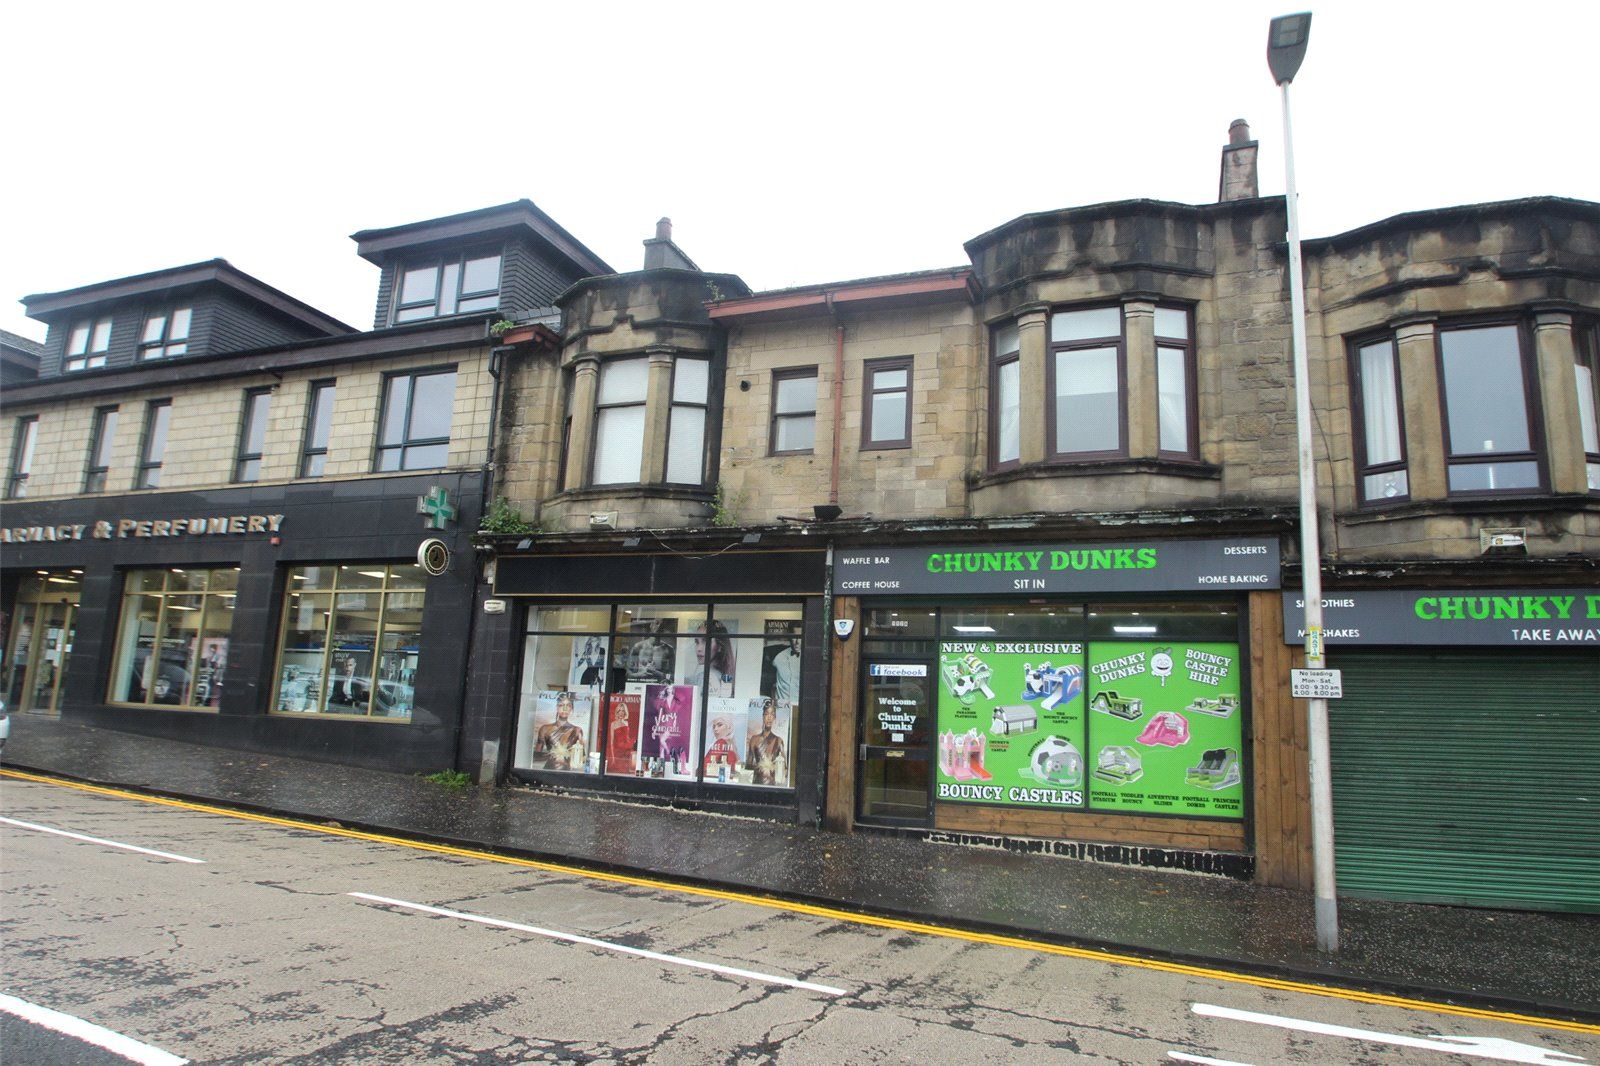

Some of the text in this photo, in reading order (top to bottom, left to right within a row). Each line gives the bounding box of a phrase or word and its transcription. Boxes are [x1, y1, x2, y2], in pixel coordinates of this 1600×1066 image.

[92, 520, 113, 539] &
[117, 513, 285, 539] PERFUMERY
[1224, 546, 1267, 555] DESSERTS
[842, 556, 890, 565] WAFFLE BAR
[926, 548, 1157, 573] CHUNKY DUNKS
[841, 580, 900, 589] COFFEE HOUSE
[1013, 578, 1046, 589] SIT IN
[1198, 574, 1269, 584] HOME BAKING
[1296, 599, 1355, 608] SOTHIES
[1414, 596, 1575, 620] CHUNKY
[1512, 629, 1551, 641] TAKE
[942, 642, 1082, 654] NEW & EXCLUSIVE
[1091, 651, 1146, 675] CHUNKY
[1185, 648, 1231, 667] BOUNCY
[883, 668, 923, 676] facebook
[1099, 663, 1146, 684] DUNKS
[1184, 659, 1228, 677] CASTLE
[1189, 671, 1219, 686] HIRE
[878, 697, 917, 706] Welcome
[655, 707, 677, 728] Very
[878, 712, 917, 724] Chunky
[881, 722, 913, 731] Dunks
[939, 783, 1083, 805] BOUNCY CASTLES
